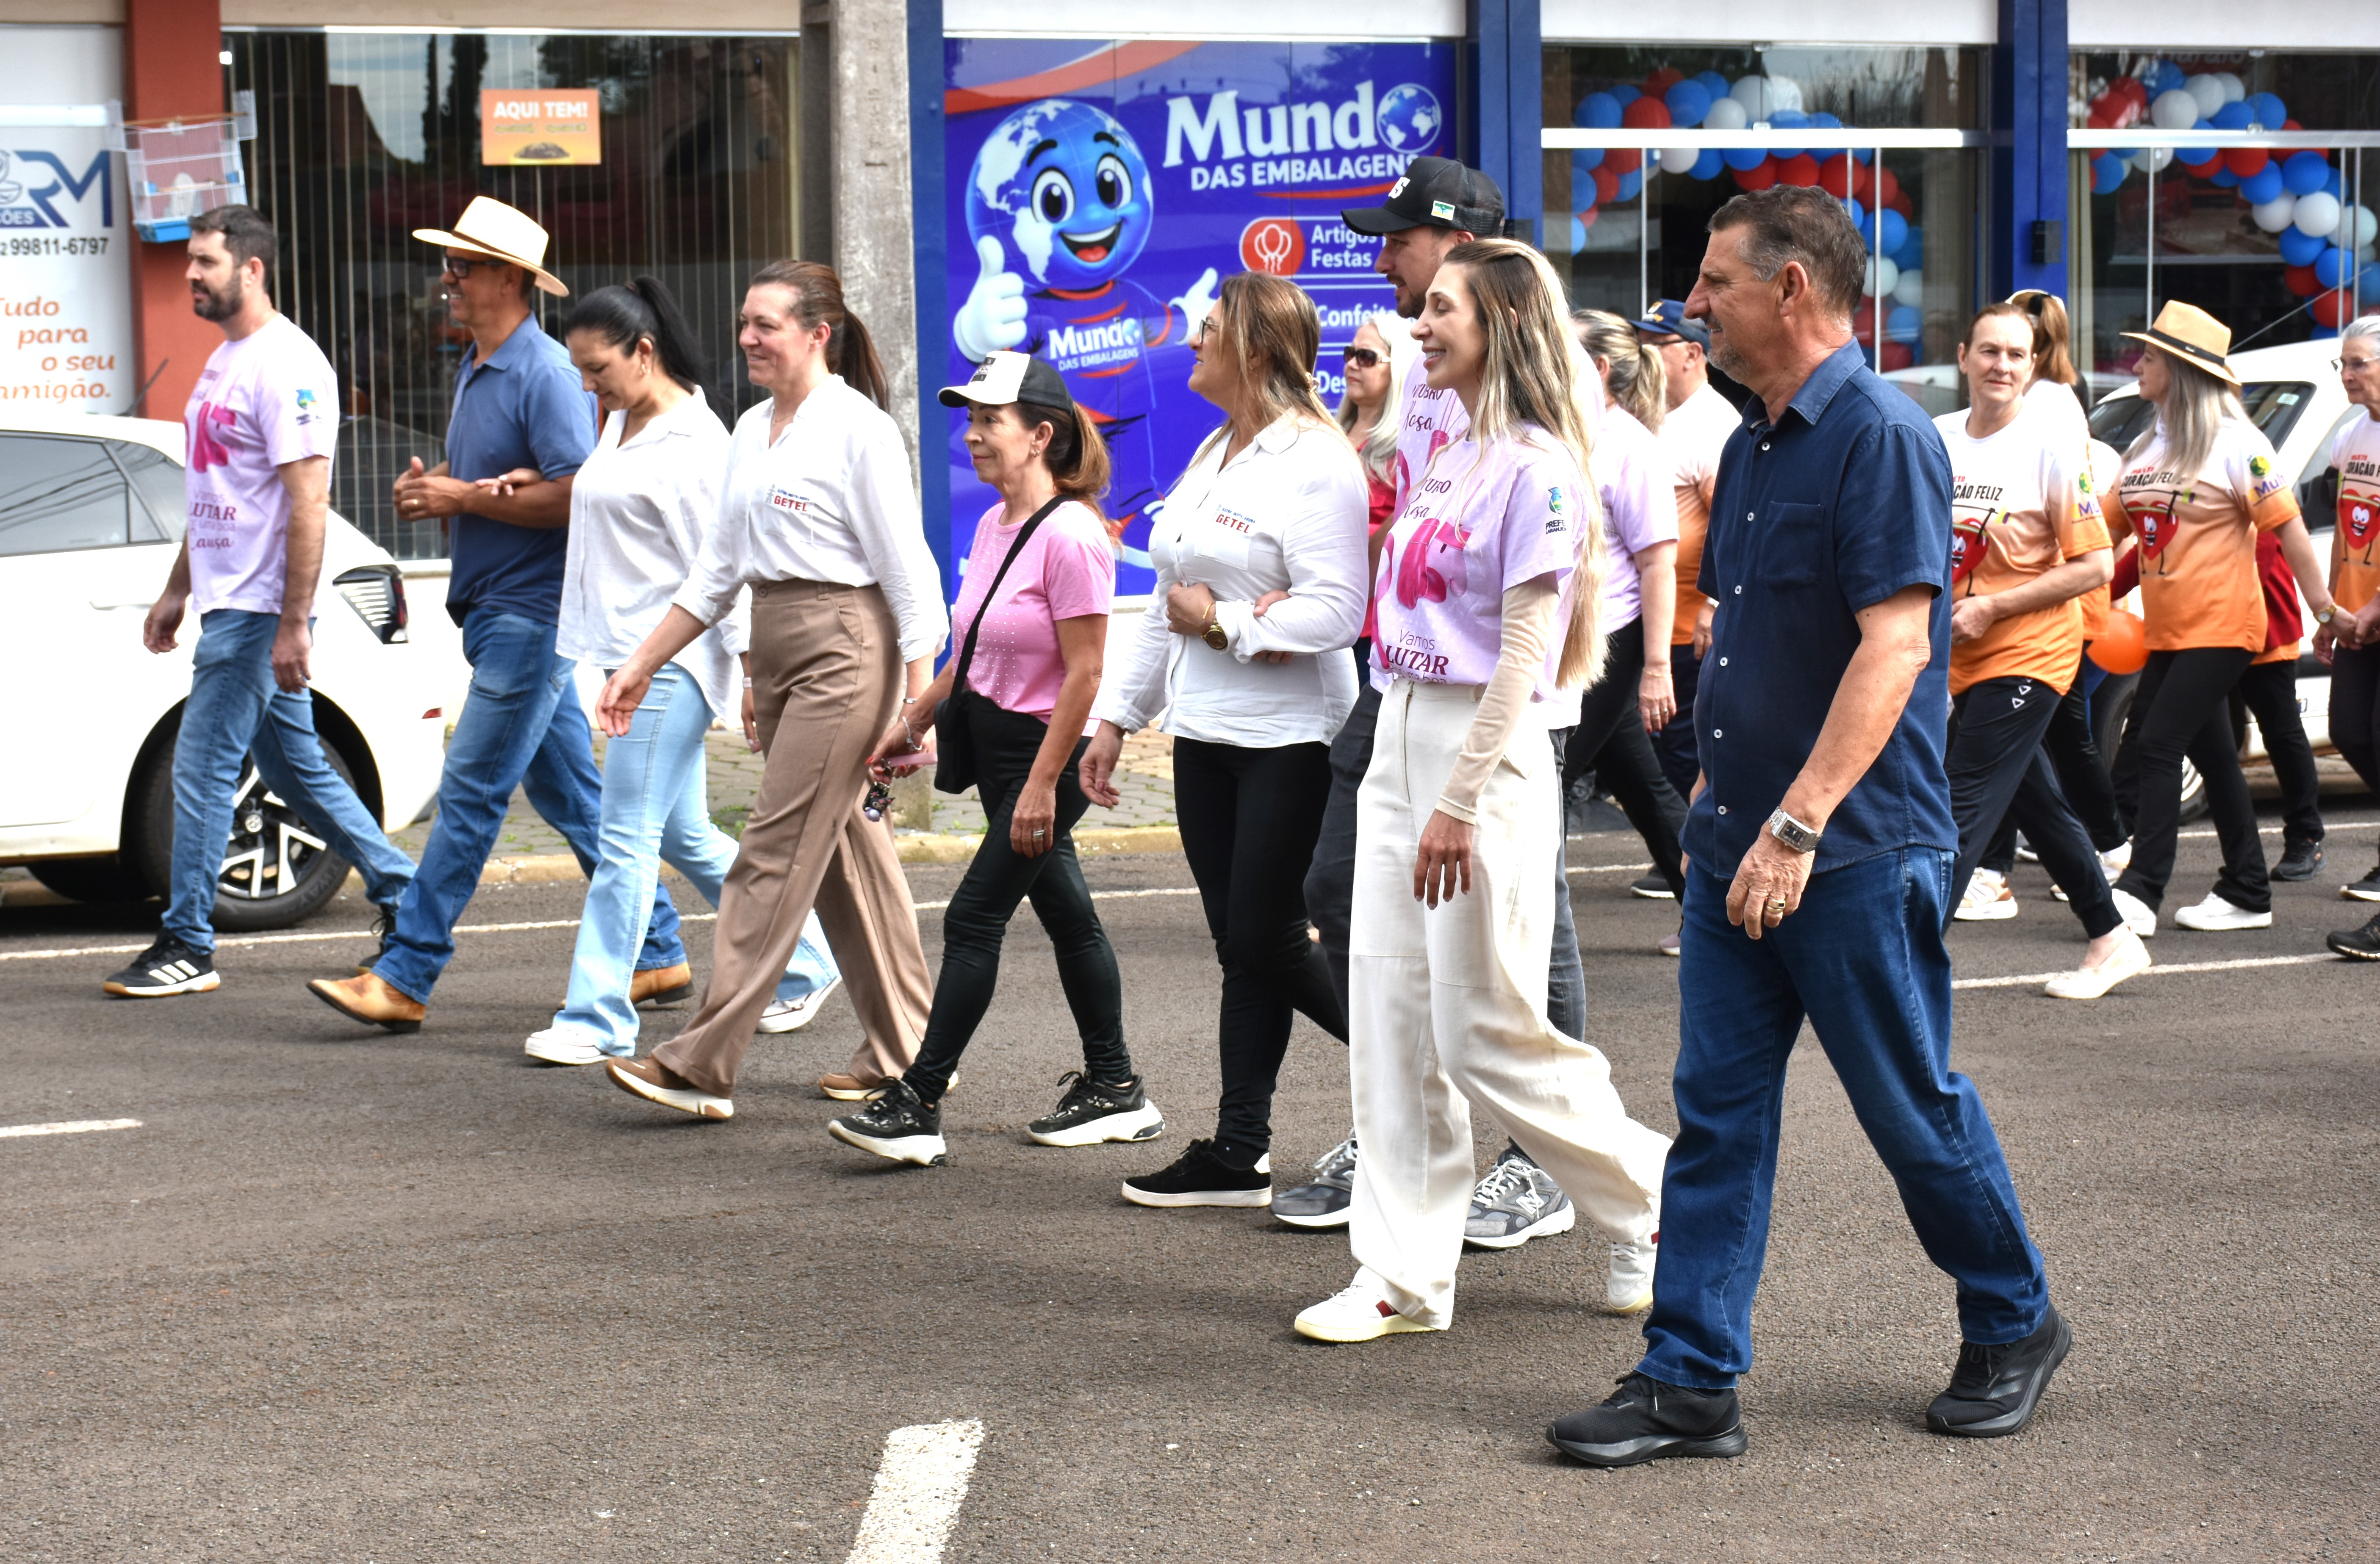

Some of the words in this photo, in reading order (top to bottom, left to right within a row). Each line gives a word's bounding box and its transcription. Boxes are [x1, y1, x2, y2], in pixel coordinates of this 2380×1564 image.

[494, 102, 540, 120] AQUI
[545, 102, 588, 118] TEM!
[1191, 163, 1245, 191] DAS
[0, 210, 35, 225] ÕES
[1311, 225, 1377, 248] Artigos
[11, 238, 109, 255] 99811-6797
[1311, 248, 1372, 267] Festas
[18, 328, 89, 350] para
[42, 356, 58, 371] o
[66, 354, 115, 371] seu
[1058, 357, 1079, 371] DAS
[1081, 347, 1139, 367] EMBALAGENS
[1974, 485, 2003, 501] FELIZ
[774, 495, 807, 512] GETEL
[1216, 514, 1250, 534] GETEL
[1400, 629, 1435, 650] Vamos
[1386, 645, 1449, 675] LUTAR
